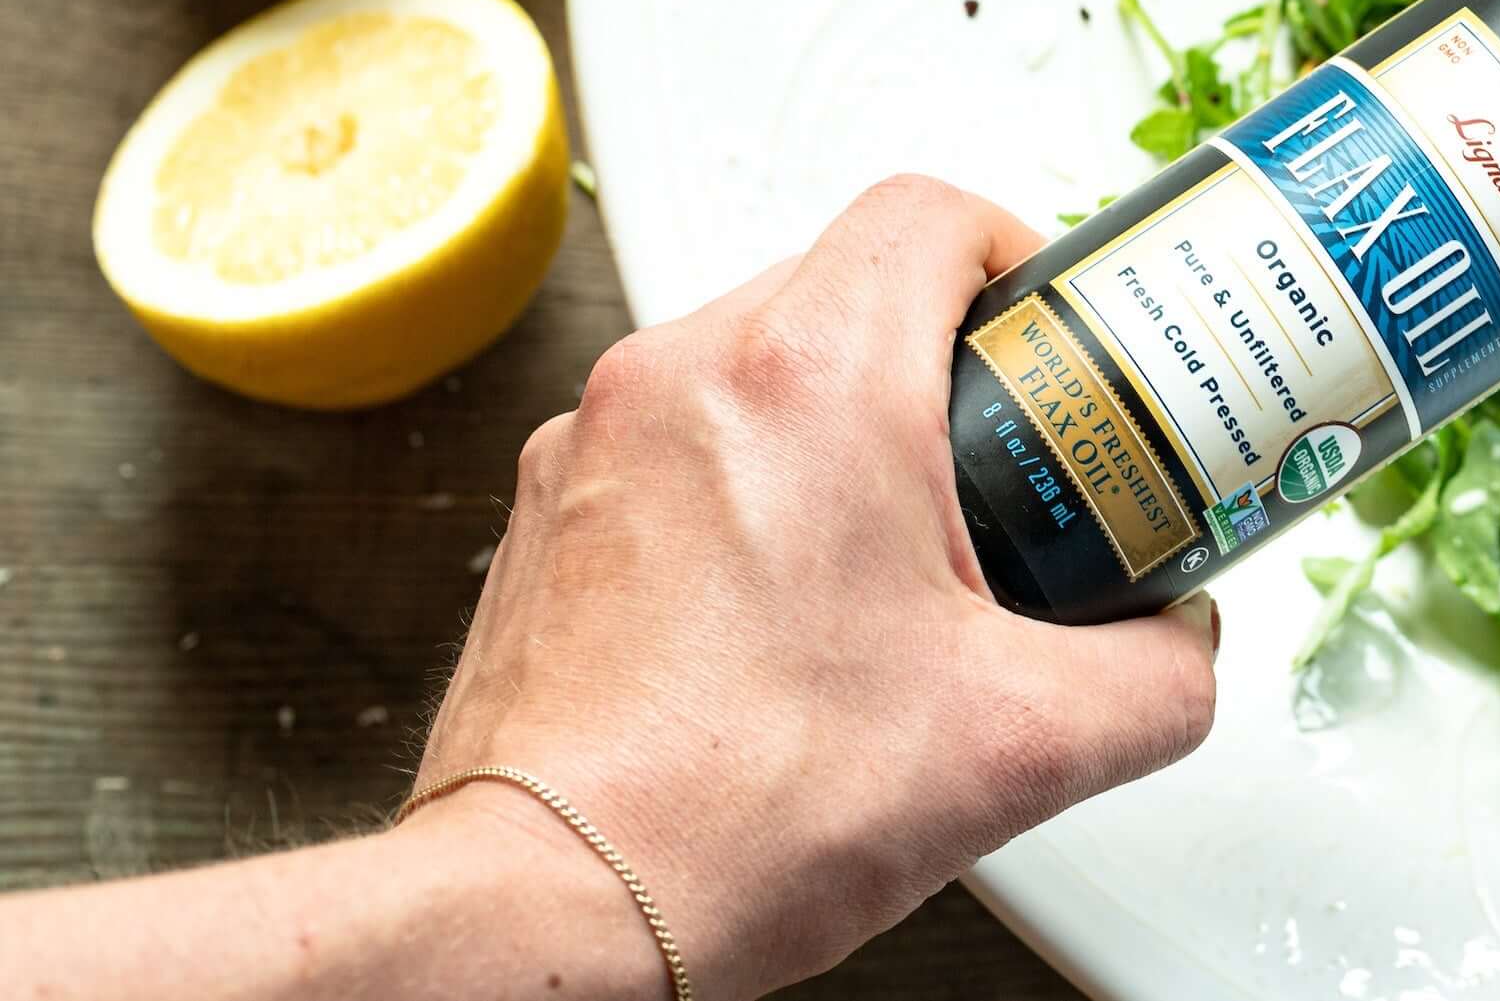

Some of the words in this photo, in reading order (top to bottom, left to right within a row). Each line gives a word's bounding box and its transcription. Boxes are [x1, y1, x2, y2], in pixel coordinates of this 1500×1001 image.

[1437, 42, 1460, 65] GMO
[1450, 33, 1473, 56] NON
[1261, 89, 1430, 264] FLAX
[1381, 239, 1495, 377] OIL
[1173, 239, 1214, 287] Pure
[1211, 287, 1233, 309] &
[1228, 310, 1307, 423] Unfiltered
[1256, 239, 1334, 348] Organic
[1018, 365, 1078, 439] FLAX
[1116, 265, 1163, 322] Fresh
[1162, 323, 1205, 375] Cold
[1198, 376, 1261, 467] Pressed
[1427, 337, 1500, 393] SUPPLEMENT
[983, 402, 1002, 418] 8
[993, 418, 1016, 438] fl
[1005, 435, 1027, 458] oz
[1026, 465, 1061, 503] 236
[1049, 501, 1074, 529] mL
[1020, 320, 1098, 419] WORLD'S
[1090, 417, 1172, 533] FRESHEST
[1294, 448, 1319, 495] ORGANIC
[1318, 434, 1345, 477] USDA
